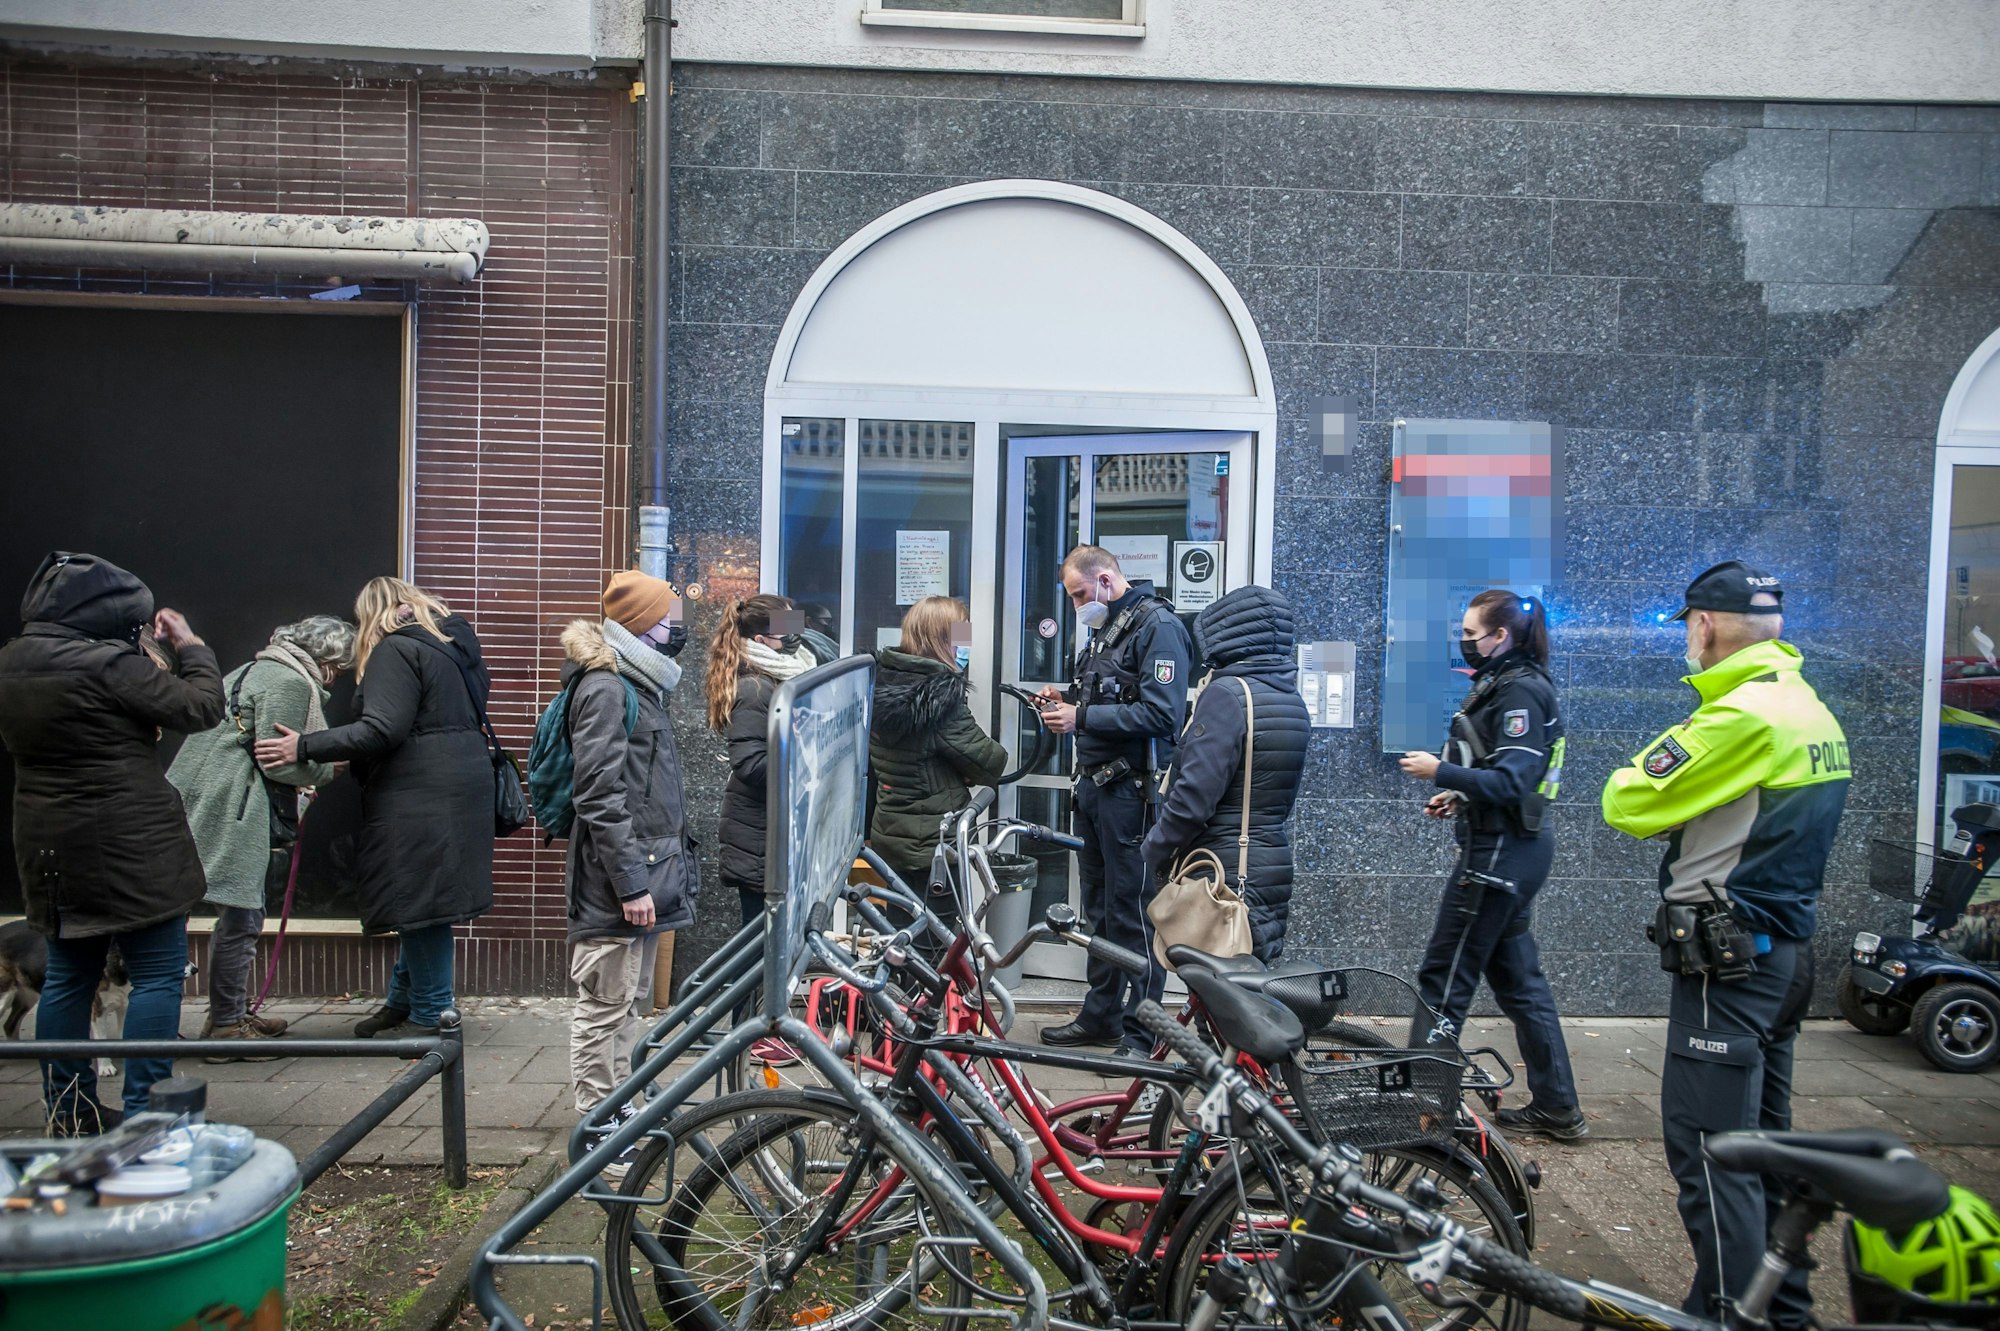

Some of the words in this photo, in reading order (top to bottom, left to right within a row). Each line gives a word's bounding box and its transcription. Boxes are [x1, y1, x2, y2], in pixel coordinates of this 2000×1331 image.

[1746, 576, 1780, 586] PLIZE
[1807, 741, 1850, 775] POLIZE
[1689, 1036, 1728, 1054] POLIZEI
